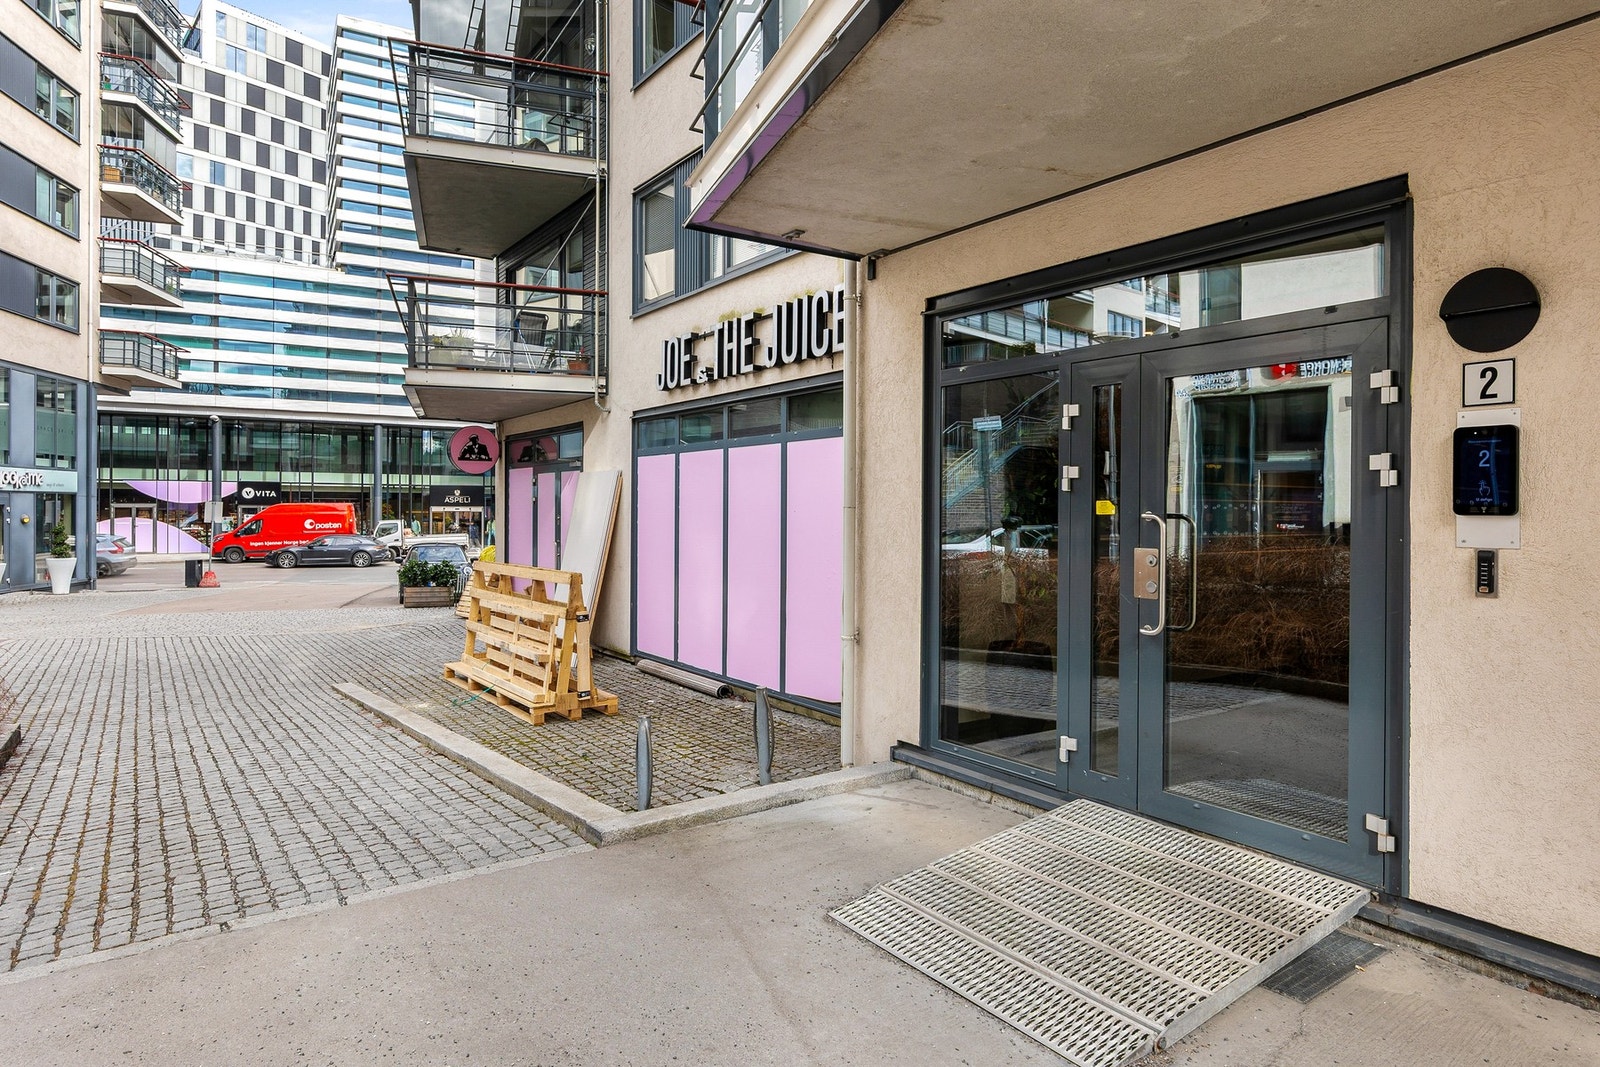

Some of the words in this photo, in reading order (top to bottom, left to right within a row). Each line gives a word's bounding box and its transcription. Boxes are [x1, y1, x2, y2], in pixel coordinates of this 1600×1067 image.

[656, 332, 694, 391] JOE
[696, 366, 710, 384] &
[711, 312, 755, 380] THE
[765, 283, 845, 369] JUICE
[1479, 366, 1498, 400] 2
[1478, 449, 1490, 467] 2
[315, 521, 343, 530] posten
